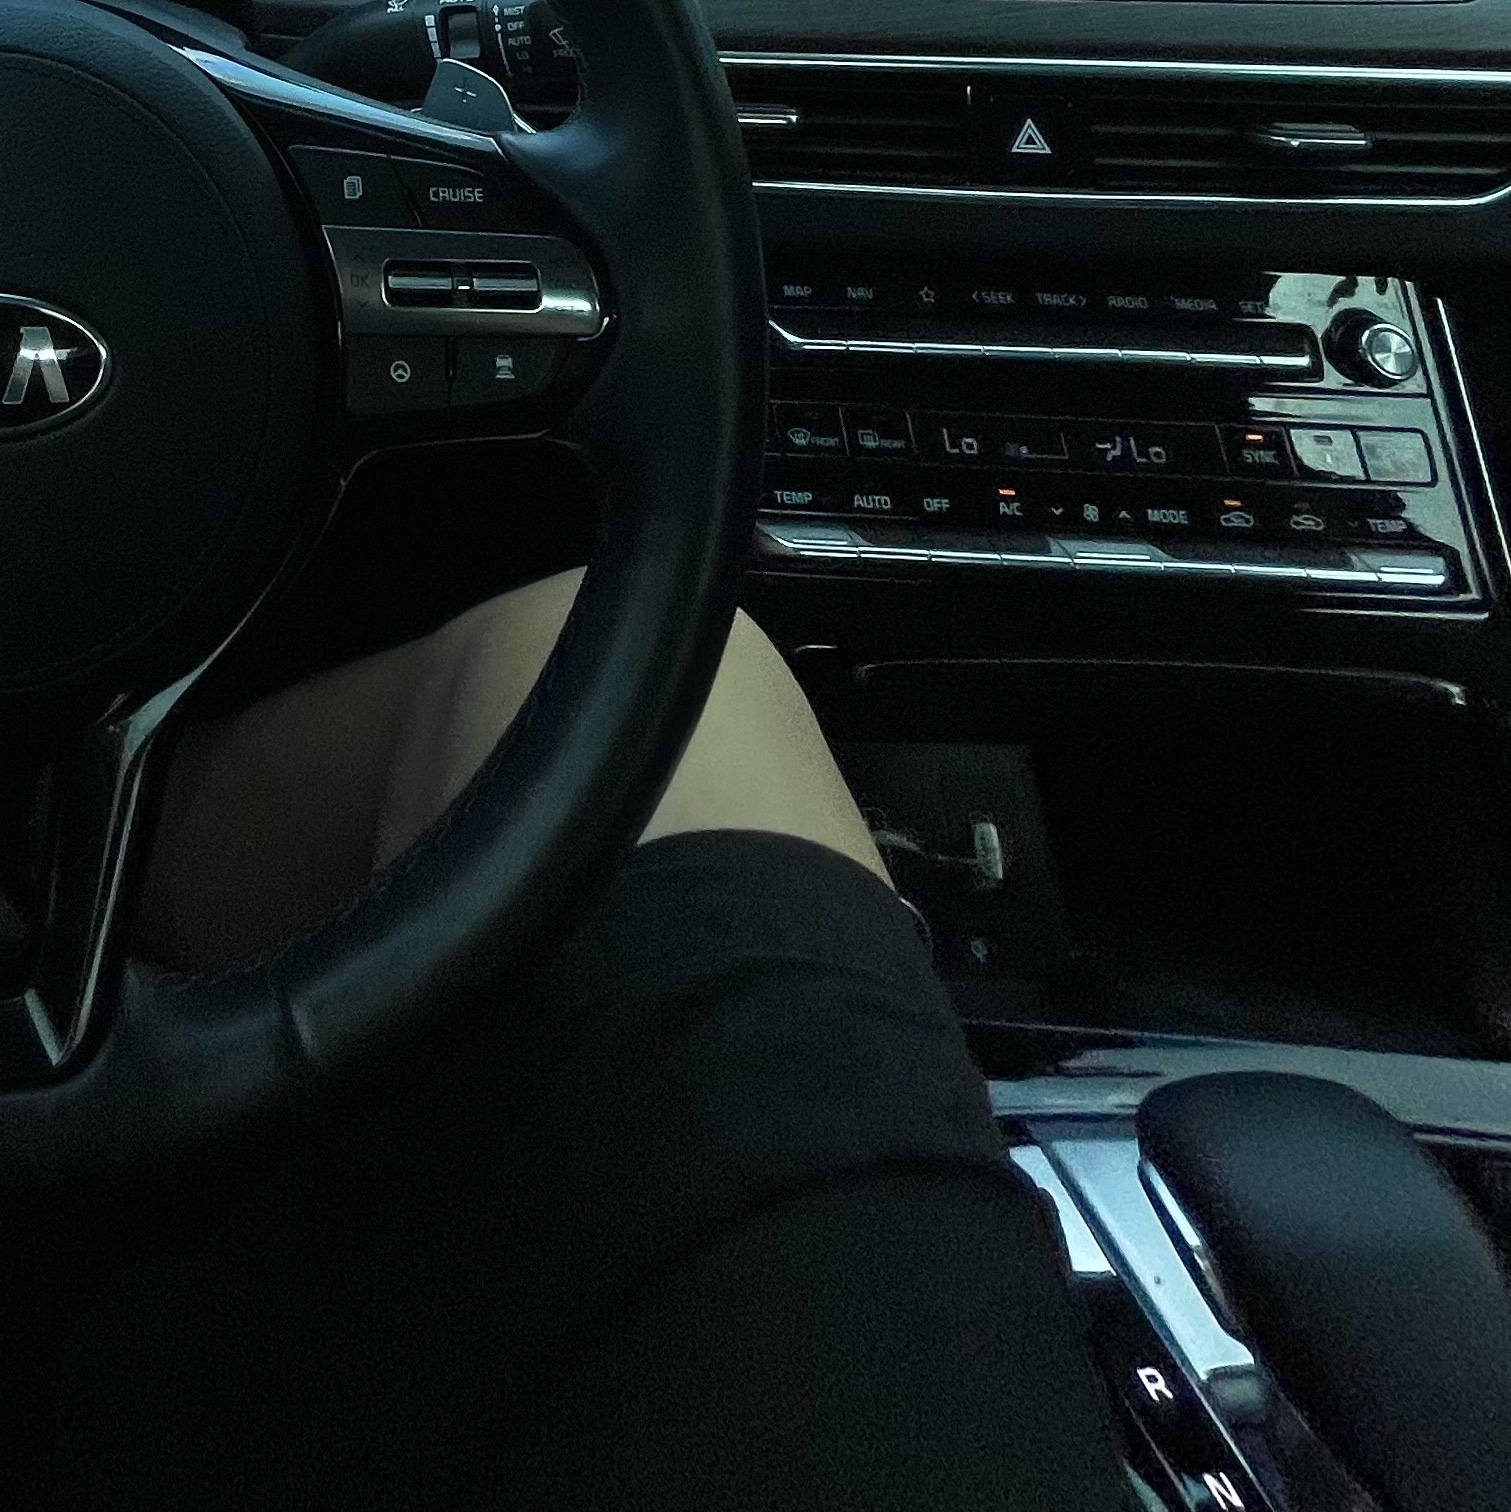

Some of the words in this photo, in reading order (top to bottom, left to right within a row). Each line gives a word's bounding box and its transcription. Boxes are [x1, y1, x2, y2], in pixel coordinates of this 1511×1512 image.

[429, 187, 484, 204] CRUISE
[774, 490, 814, 506] TEMP
[853, 493, 892, 510] AUTO
[923, 497, 952, 513] OFF
[1146, 507, 1189, 525] MODE
[1136, 1366, 1174, 1401] R
[1203, 1471, 1246, 1510] N
